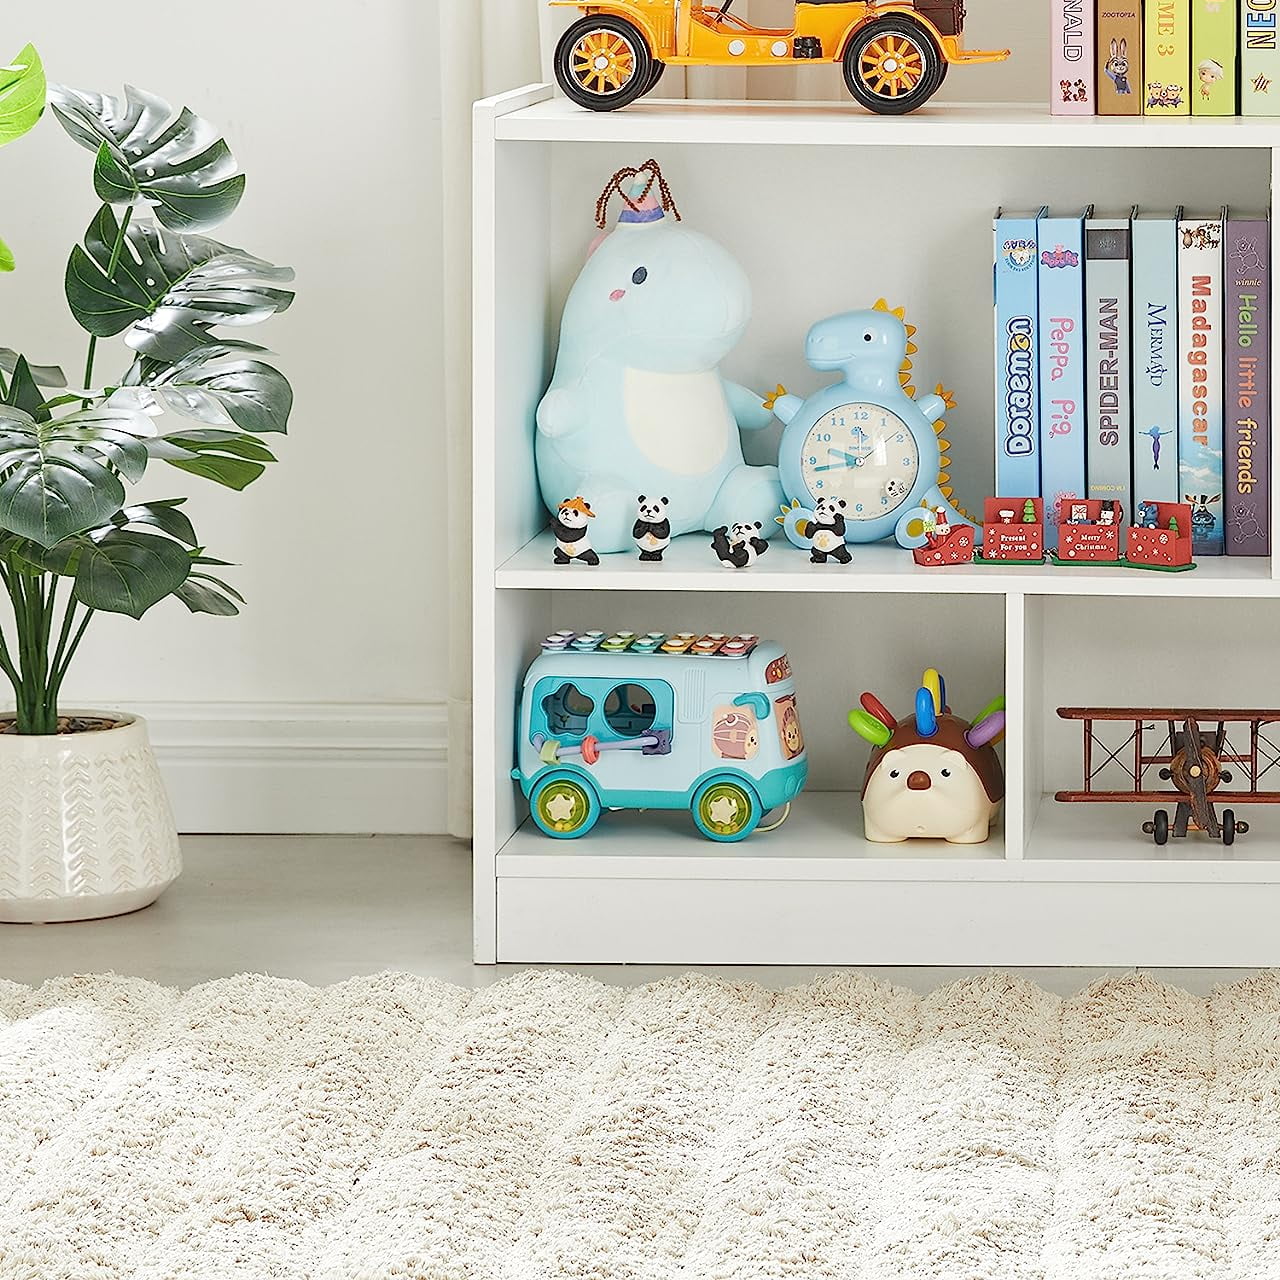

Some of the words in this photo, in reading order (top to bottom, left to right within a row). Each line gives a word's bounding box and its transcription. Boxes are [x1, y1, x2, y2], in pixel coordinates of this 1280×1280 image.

[1158, 2, 1174, 35] ME
[1158, 44, 1175, 56] 3
[1238, 294, 1258, 347] Hello
[1049, 318, 1074, 381] Peppa
[1188, 276, 1211, 446] Madagascar
[1099, 298, 1118, 446] SPIDER-MAN
[1006, 316, 1033, 456] Doraemon
[1238, 357, 1258, 408] little
[854, 411, 869, 420] 12
[1048, 400, 1075, 438] Pig
[831, 417, 846, 426] 11
[880, 418, 887, 426] 1
[816, 434, 831, 442] 10
[896, 435, 904, 443] 2
[809, 456, 817, 465] 9
[1237, 418, 1258, 494] friends
[902, 458, 910, 466] 3
[816, 480, 823, 489] 8
[881, 497, 888, 505] 5
[855, 503, 863, 512] 6
